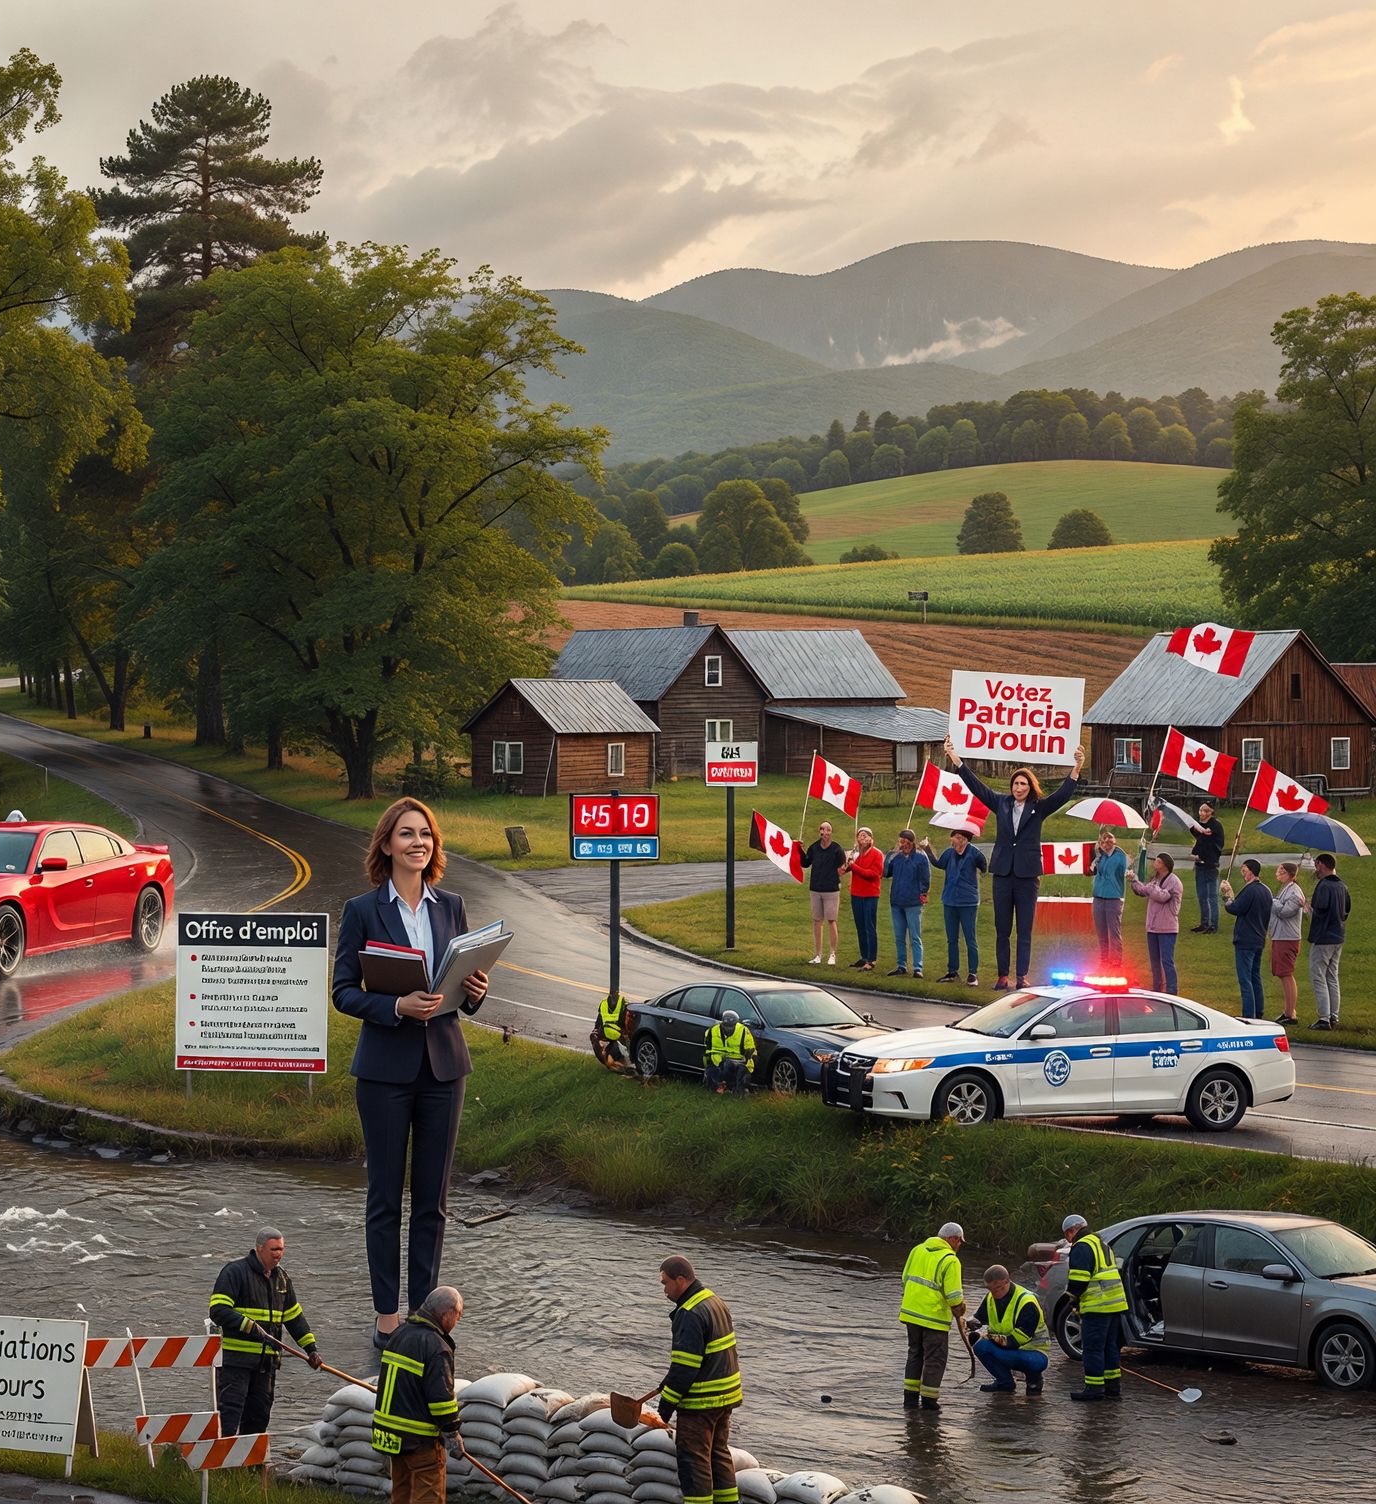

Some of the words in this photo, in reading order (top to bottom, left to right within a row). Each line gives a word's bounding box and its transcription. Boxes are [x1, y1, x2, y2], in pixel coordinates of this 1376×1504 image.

[985, 679, 1052, 703] Votez
[958, 698, 1071, 730] Patricia
[965, 723, 1066, 754] Drouin
[185, 920, 234, 939] Offre
[239, 921, 318, 944] d'emploi
